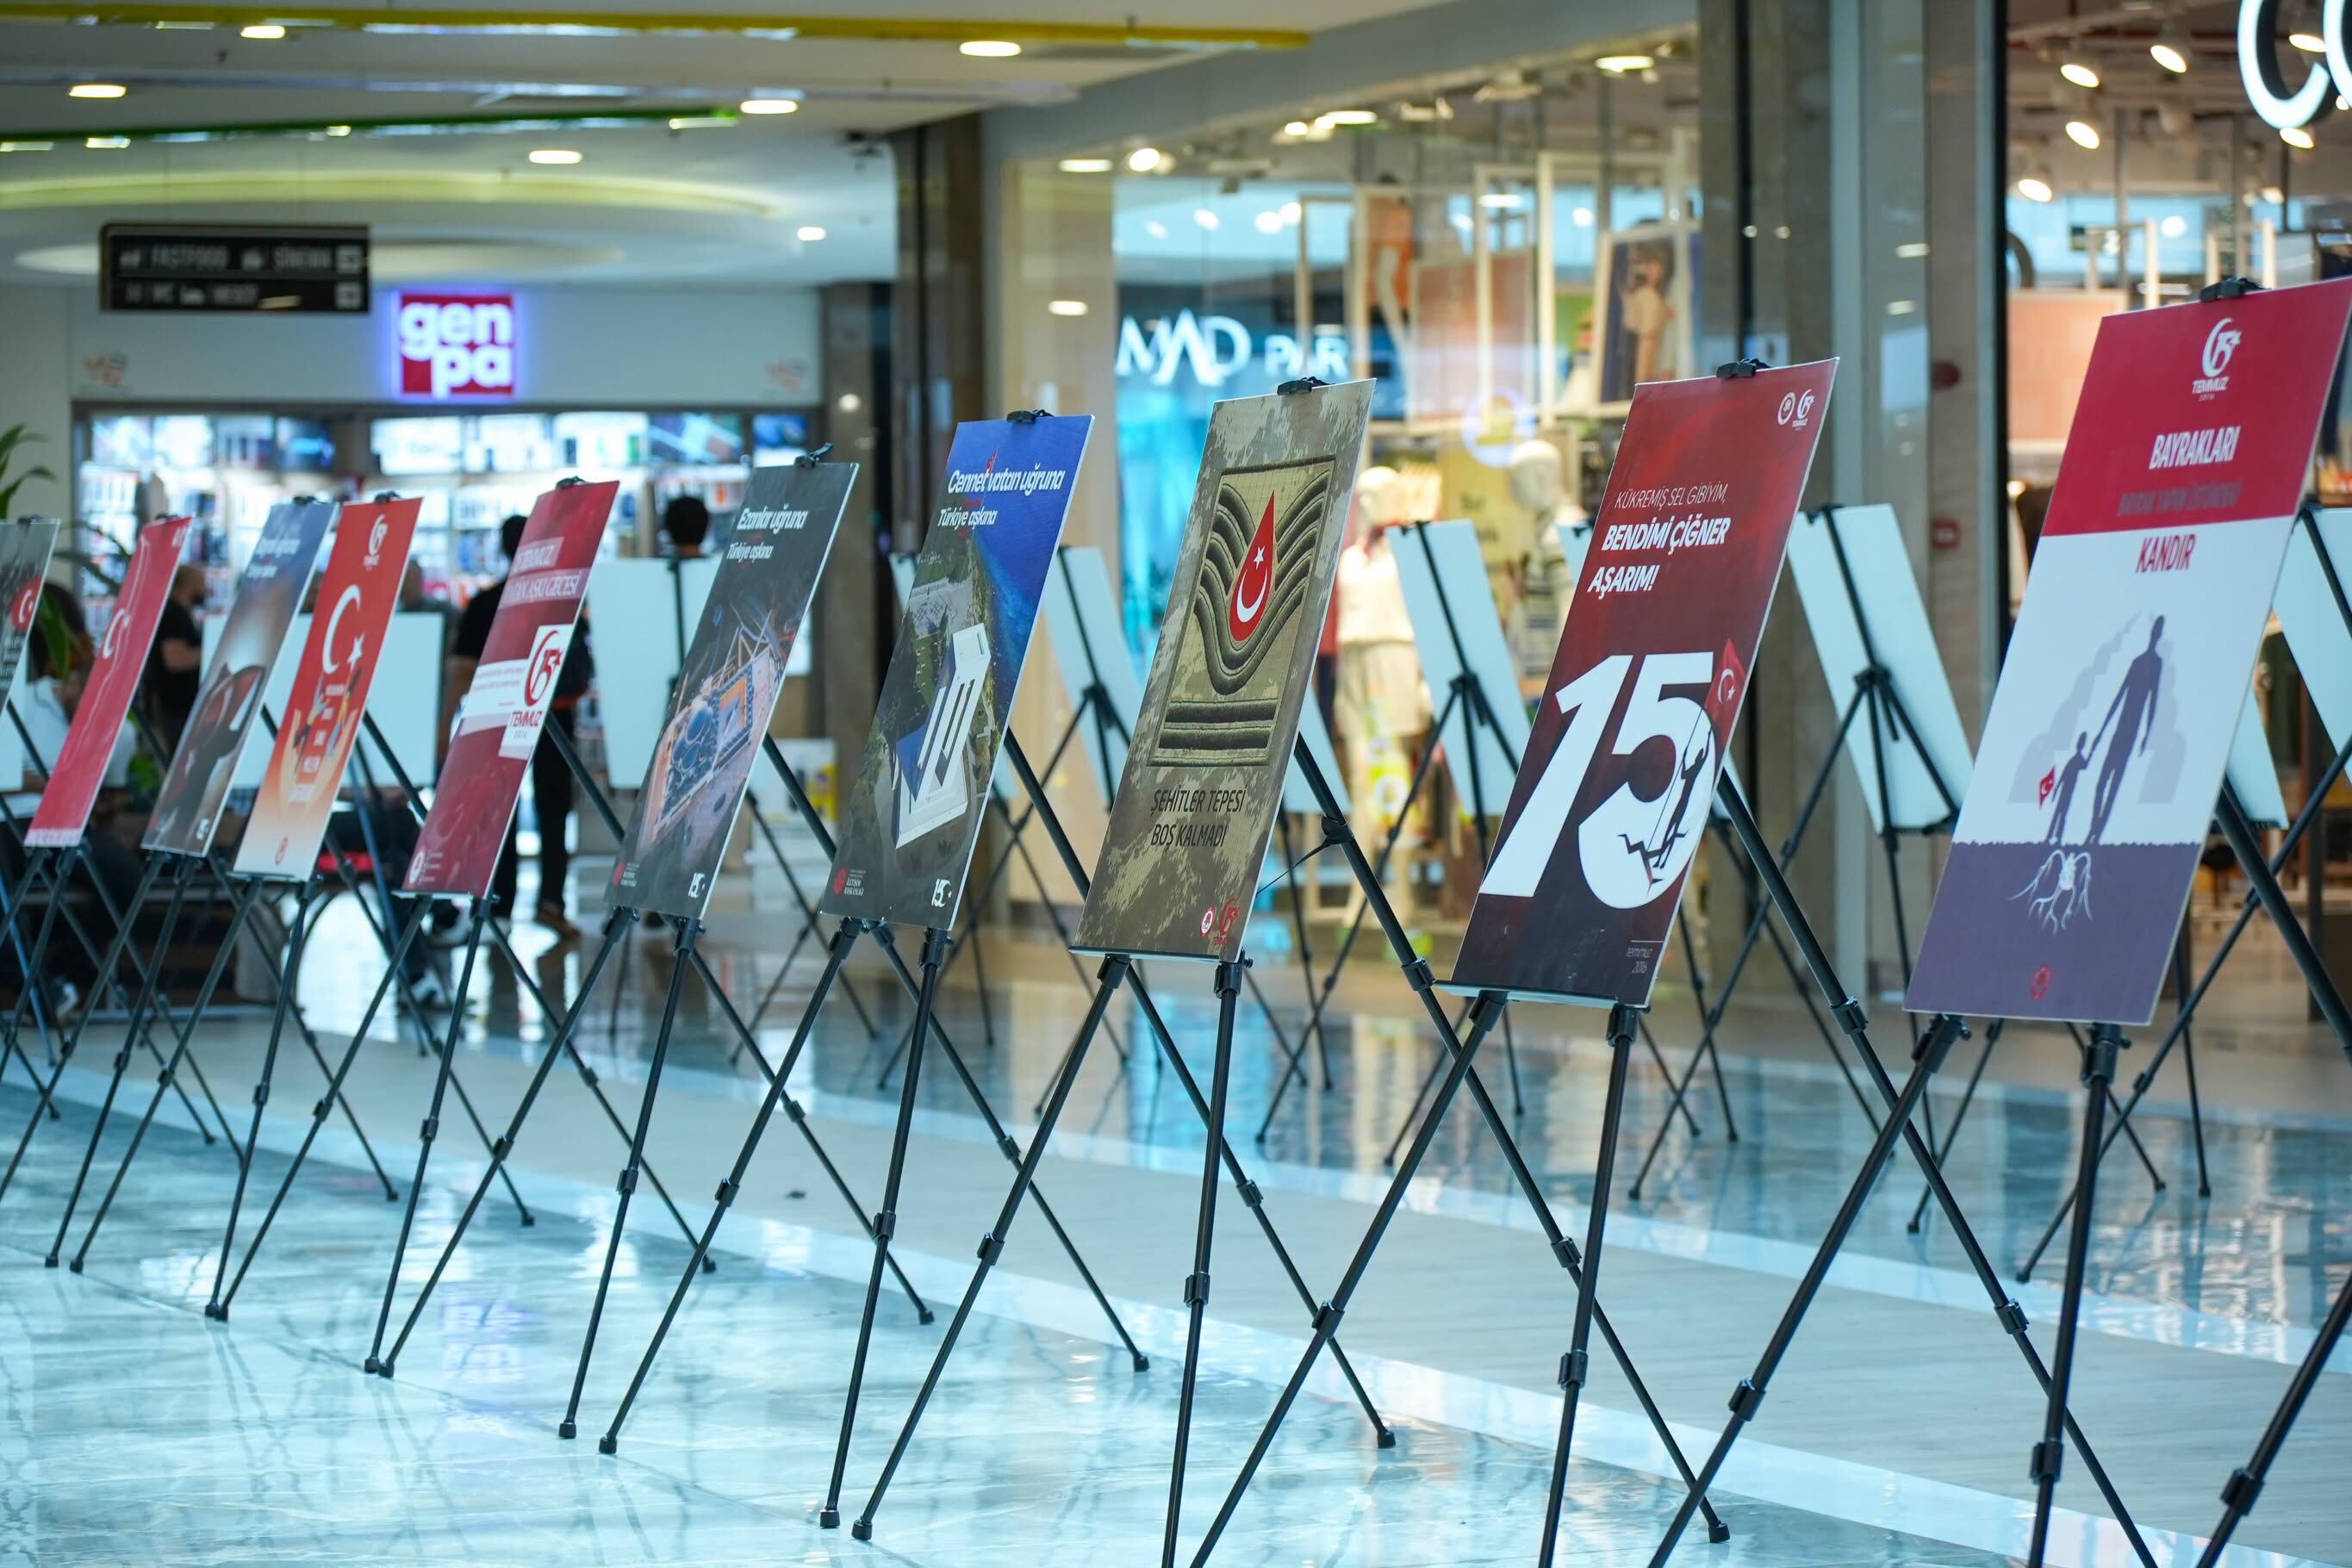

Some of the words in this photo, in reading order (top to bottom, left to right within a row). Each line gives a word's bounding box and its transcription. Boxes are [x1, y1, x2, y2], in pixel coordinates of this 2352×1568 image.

[1116, 307, 1252, 386] MAD
[2149, 426, 2242, 470] BAYRAKLARI
[948, 468, 991, 494] Cennet
[986, 468, 1022, 492] vatan
[1019, 463, 1067, 496] uğruna
[1615, 487, 1670, 510] KÜKREMİŞ
[1667, 488, 1685, 507] SEL
[737, 506, 774, 530] Ezanlar
[769, 503, 809, 534] uğruna
[937, 507, 969, 531] Türkiye
[968, 506, 998, 531] aşkına
[1601, 516, 1675, 551] BENDİMİ
[1667, 513, 1732, 556] ÇİĞNER
[2134, 534, 2195, 574] KANDIR
[1587, 564, 1660, 600] AŞARIM!
[511, 710, 544, 728] TEMMUZ
[1478, 651, 1716, 909] 15
[1150, 785, 1206, 817] ŞEHİTLER
[1207, 785, 1248, 812] TEPESİ
[1150, 824, 1177, 851] BOŞ
[1175, 824, 1229, 847] KALMADI
